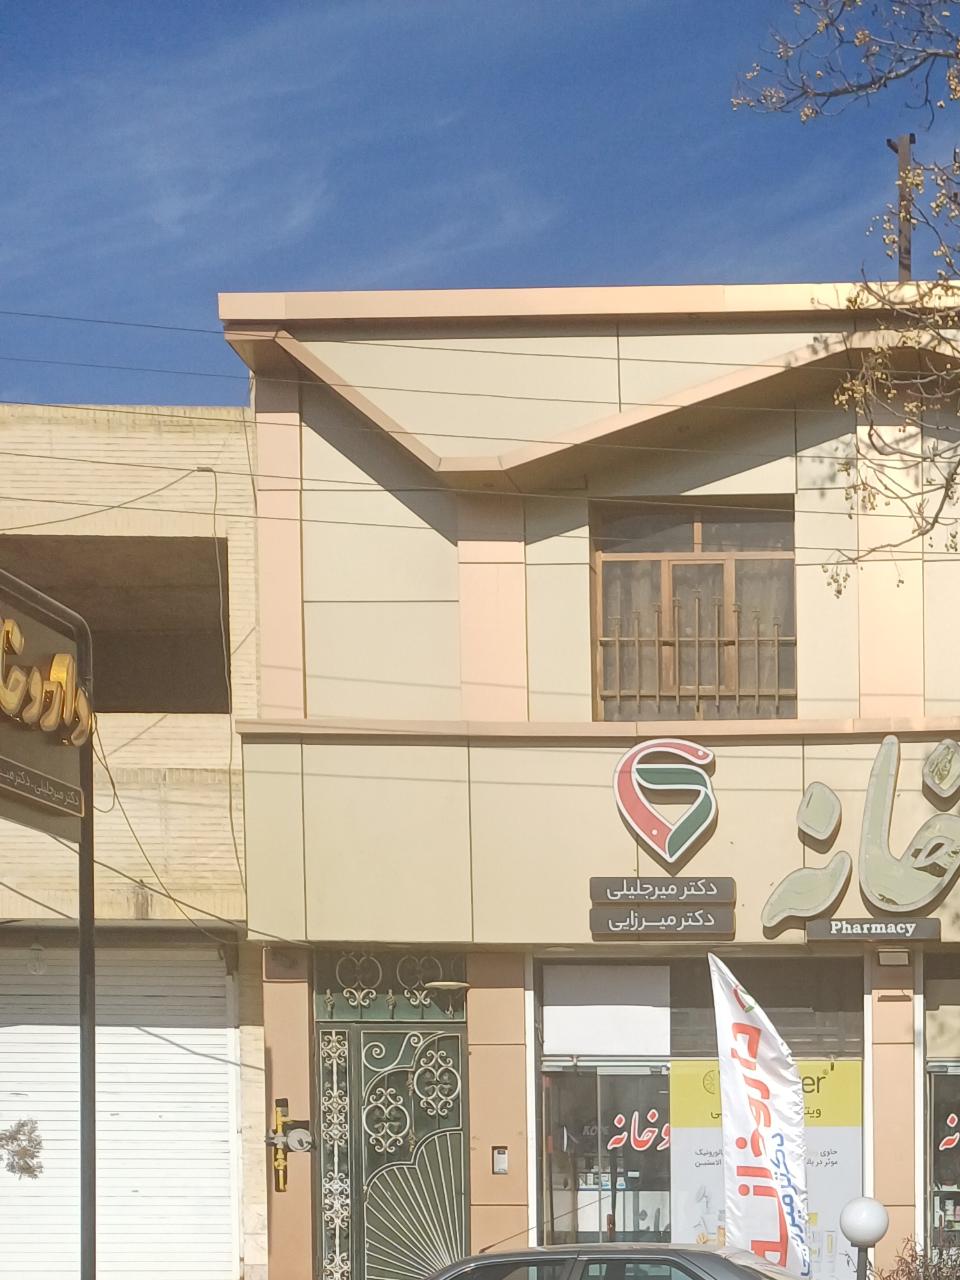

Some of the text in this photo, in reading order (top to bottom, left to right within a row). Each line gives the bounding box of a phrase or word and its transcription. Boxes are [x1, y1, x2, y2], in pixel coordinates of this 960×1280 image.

[606, 879, 717, 900] دکتر میرجلیلی
[608, 910, 715, 931] دکتر میرزایی
[830, 920, 916, 937] Pharmacy
